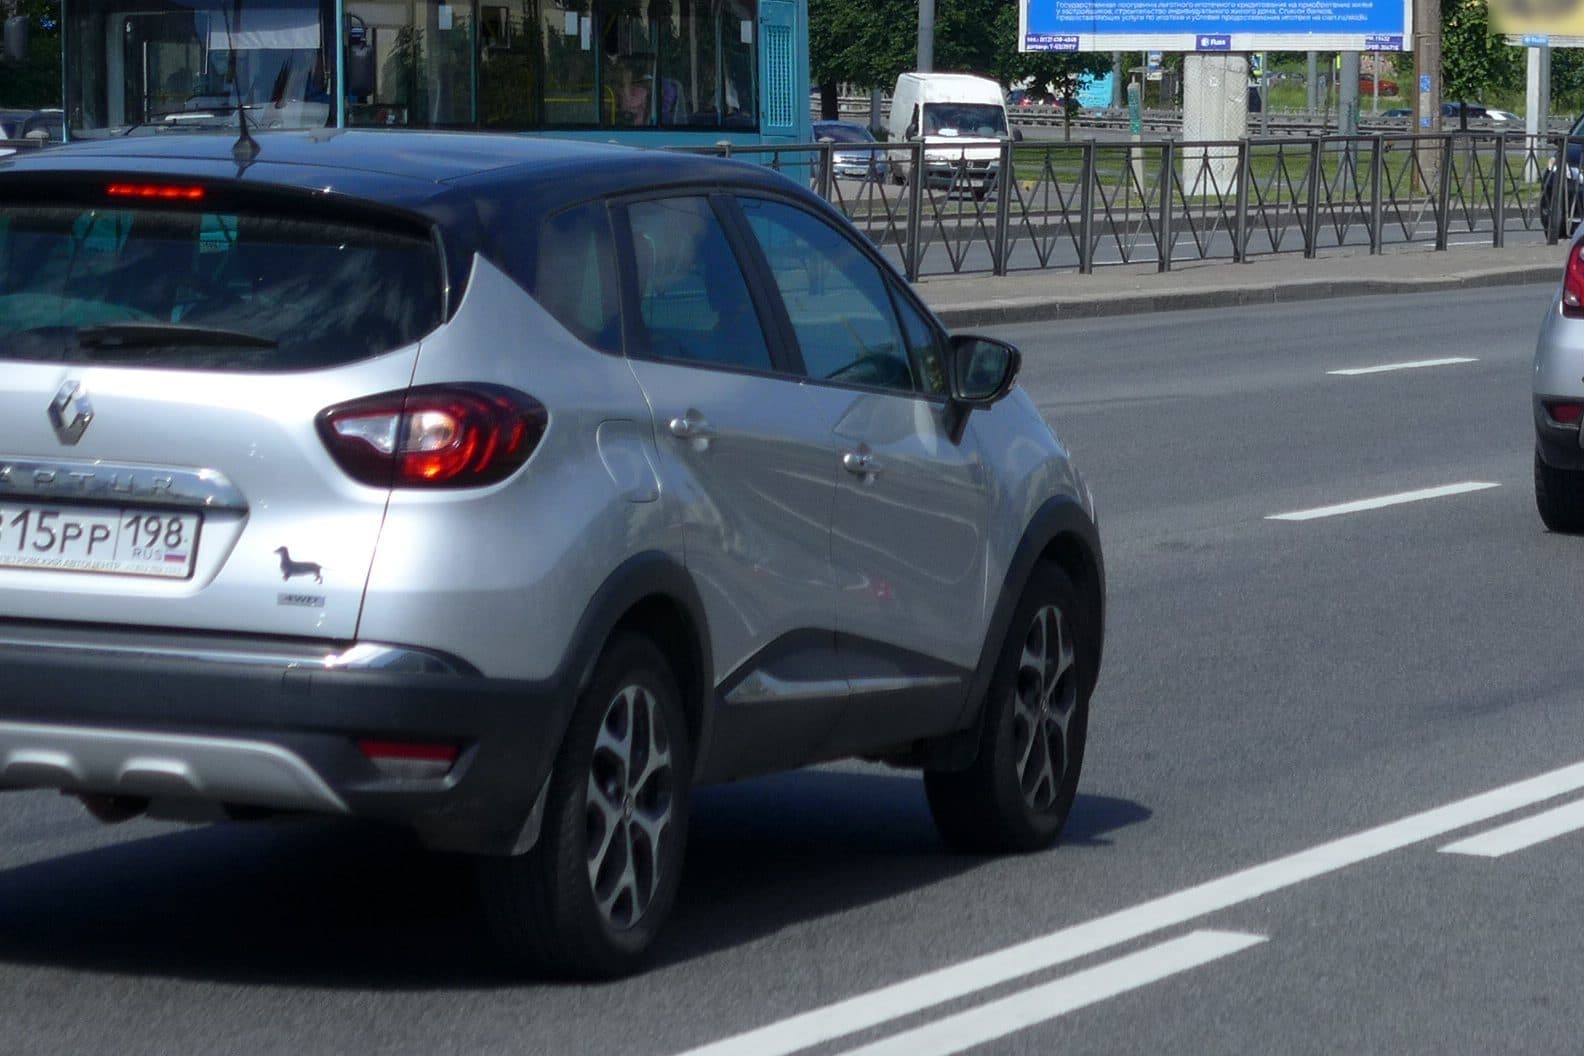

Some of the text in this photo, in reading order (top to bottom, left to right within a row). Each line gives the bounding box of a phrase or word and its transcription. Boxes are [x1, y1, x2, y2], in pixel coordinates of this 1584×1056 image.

[0, 508, 184, 555] 15РР 198
[132, 548, 163, 561] RUS
